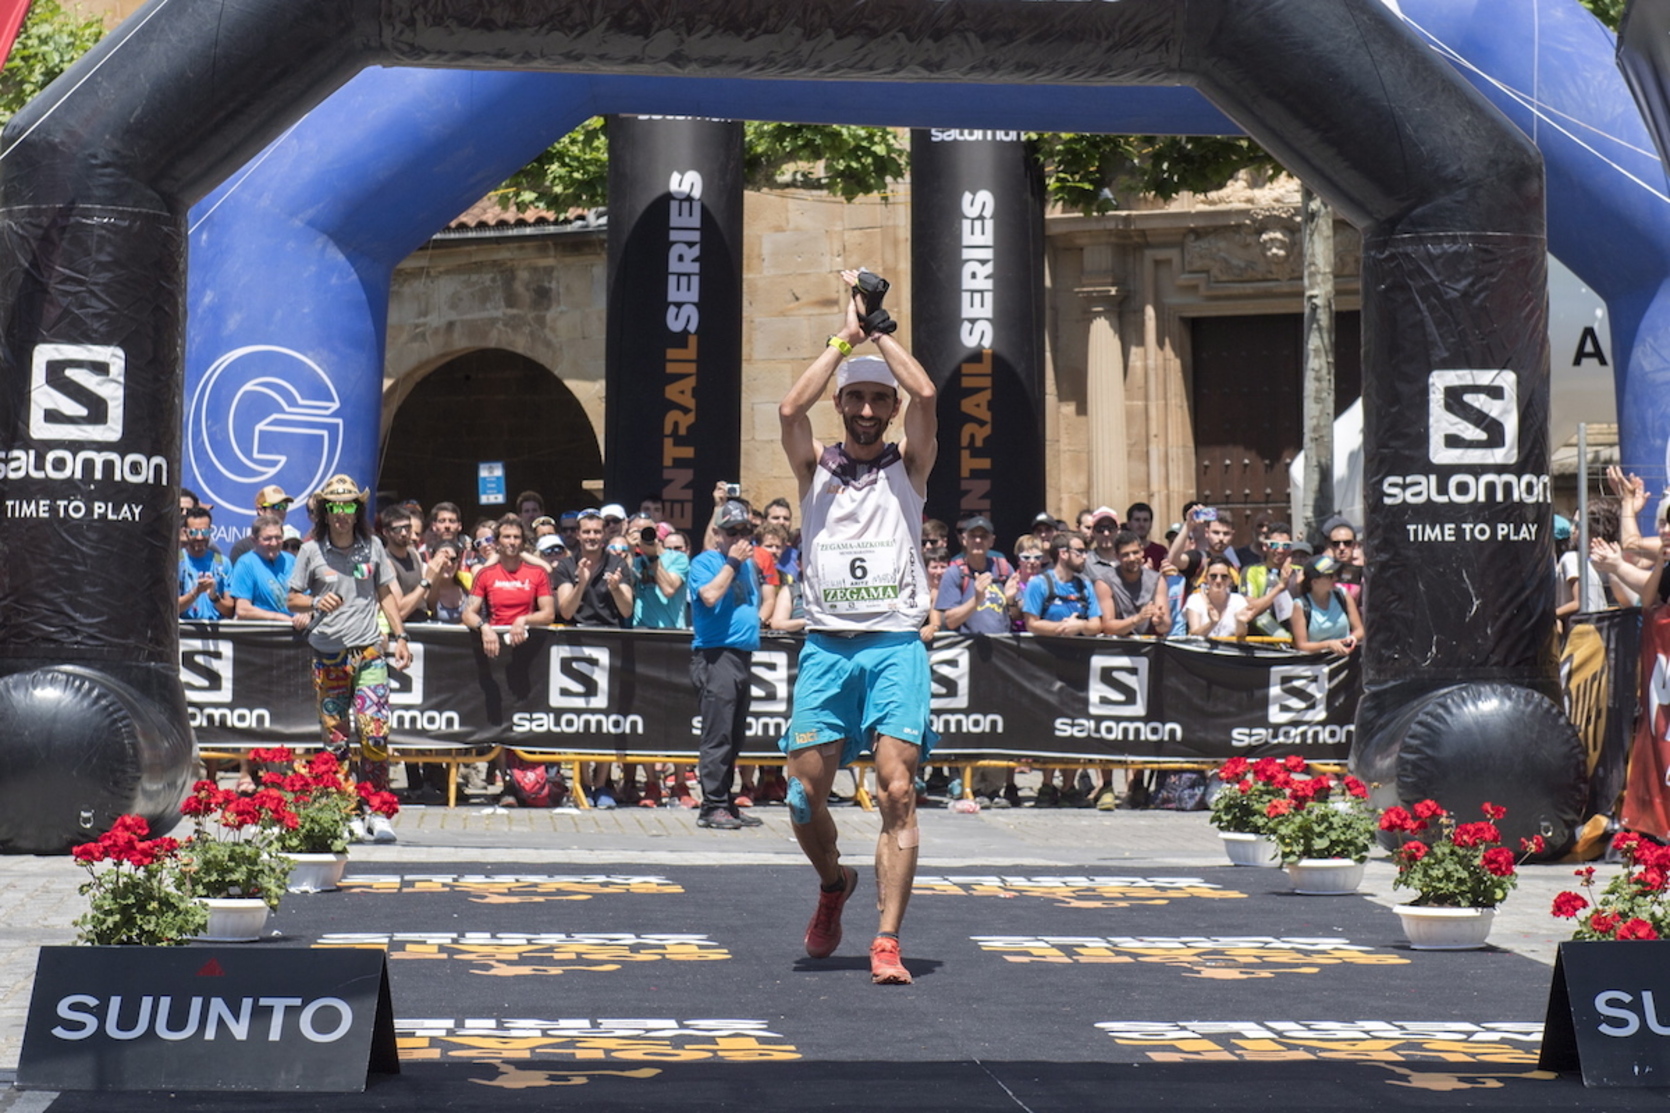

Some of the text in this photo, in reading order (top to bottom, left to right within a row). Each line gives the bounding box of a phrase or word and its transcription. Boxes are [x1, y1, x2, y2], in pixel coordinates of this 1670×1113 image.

[666, 170, 703, 333] SERIES
[960, 189, 995, 349] SERIES
[1382, 473, 1551, 505] salomon
[5, 500, 143, 521] TIME TO PLAY
[1406, 523, 1538, 542] TIME TO PLAY
[849, 557, 868, 580] 6
[825, 585, 896, 601] ZEGAMA
[188, 708, 270, 728] omon
[512, 712, 644, 734] salomon
[929, 714, 1004, 733] omon
[1054, 718, 1182, 741] salomon
[51, 994, 353, 1043] SUUNTO
